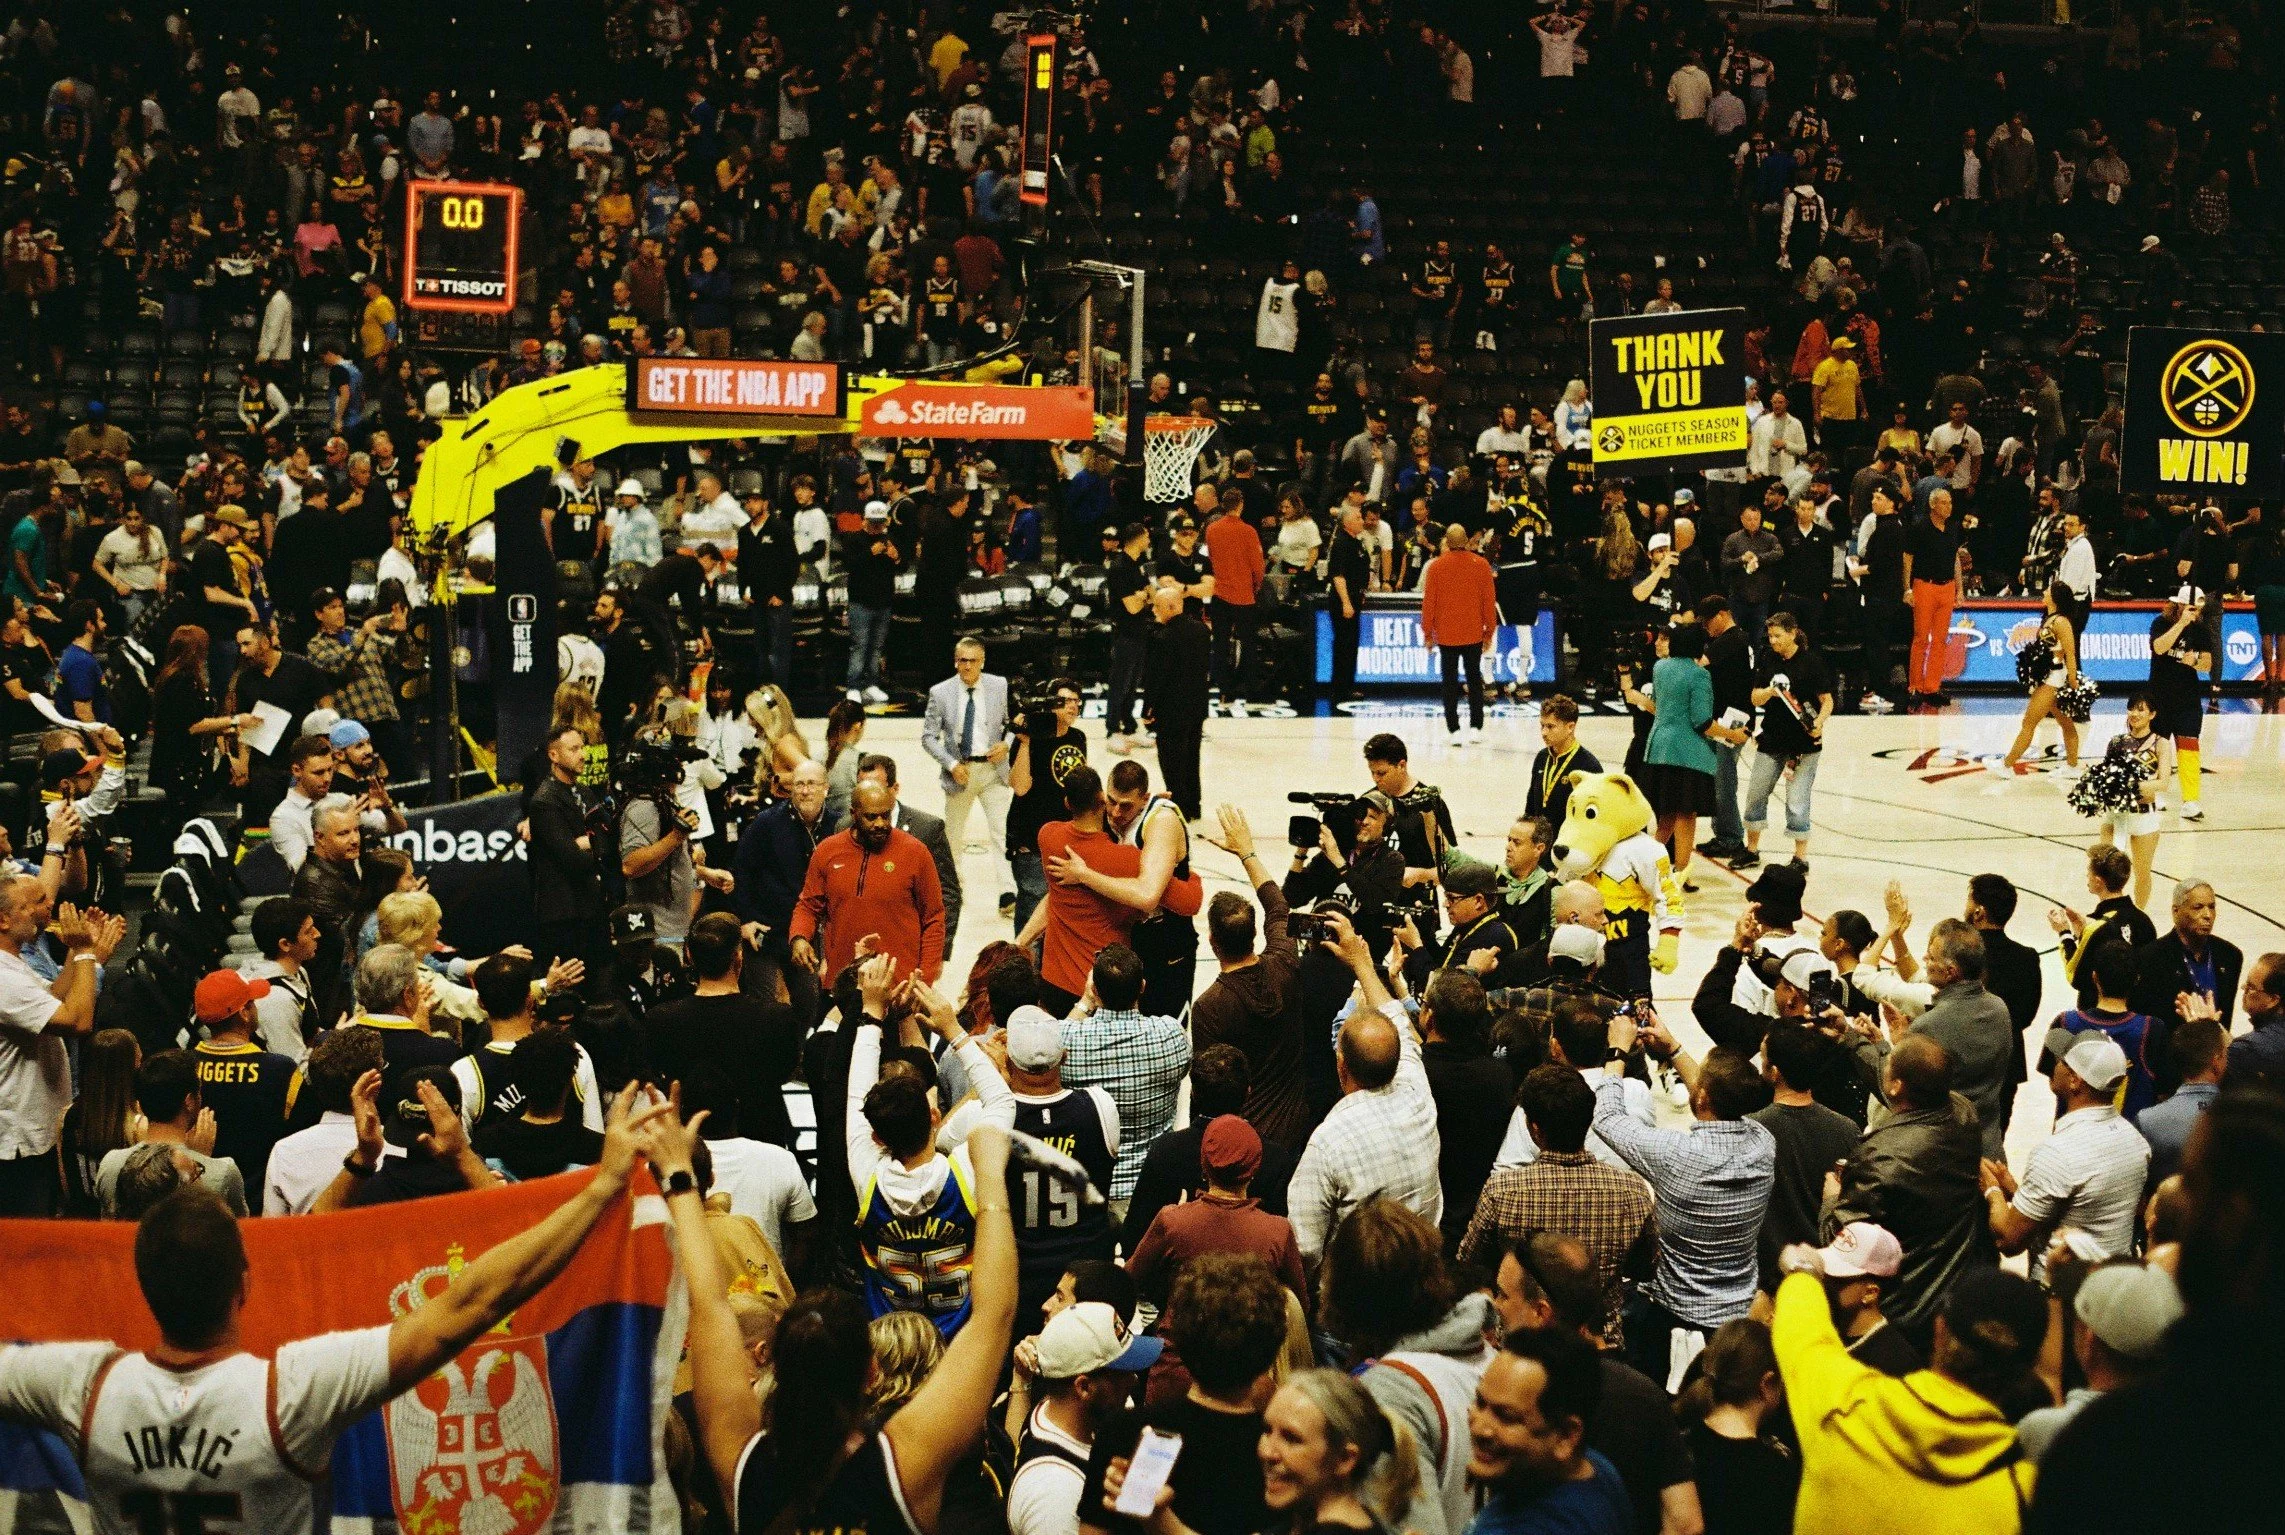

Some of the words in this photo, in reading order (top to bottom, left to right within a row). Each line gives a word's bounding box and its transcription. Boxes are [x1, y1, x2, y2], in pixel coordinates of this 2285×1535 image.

[442, 197, 485, 229] 0.0
[1801, 205, 1817, 222] 27
[440, 279, 507, 296] TISSOT
[1611, 329, 1725, 373] THANK
[649, 367, 690, 403] GET
[692, 368, 735, 405] THE
[737, 370, 781, 406] NBA
[784, 372, 827, 408] APP
[1634, 369, 1701, 410] YOU
[1628, 420, 1686, 437] NUGGETS
[1690, 416, 1740, 432] SEASON
[1629, 434, 1673, 450] TICKET
[1676, 430, 1738, 447] MEMBERS
[2159, 438, 2250, 486] WIN!
[1373, 617, 1414, 647] HEAT
[2227, 642, 2256, 655] TNT
[878, 1243, 972, 1313] 55
[124, 1426, 240, 1480] JOKIĆ
